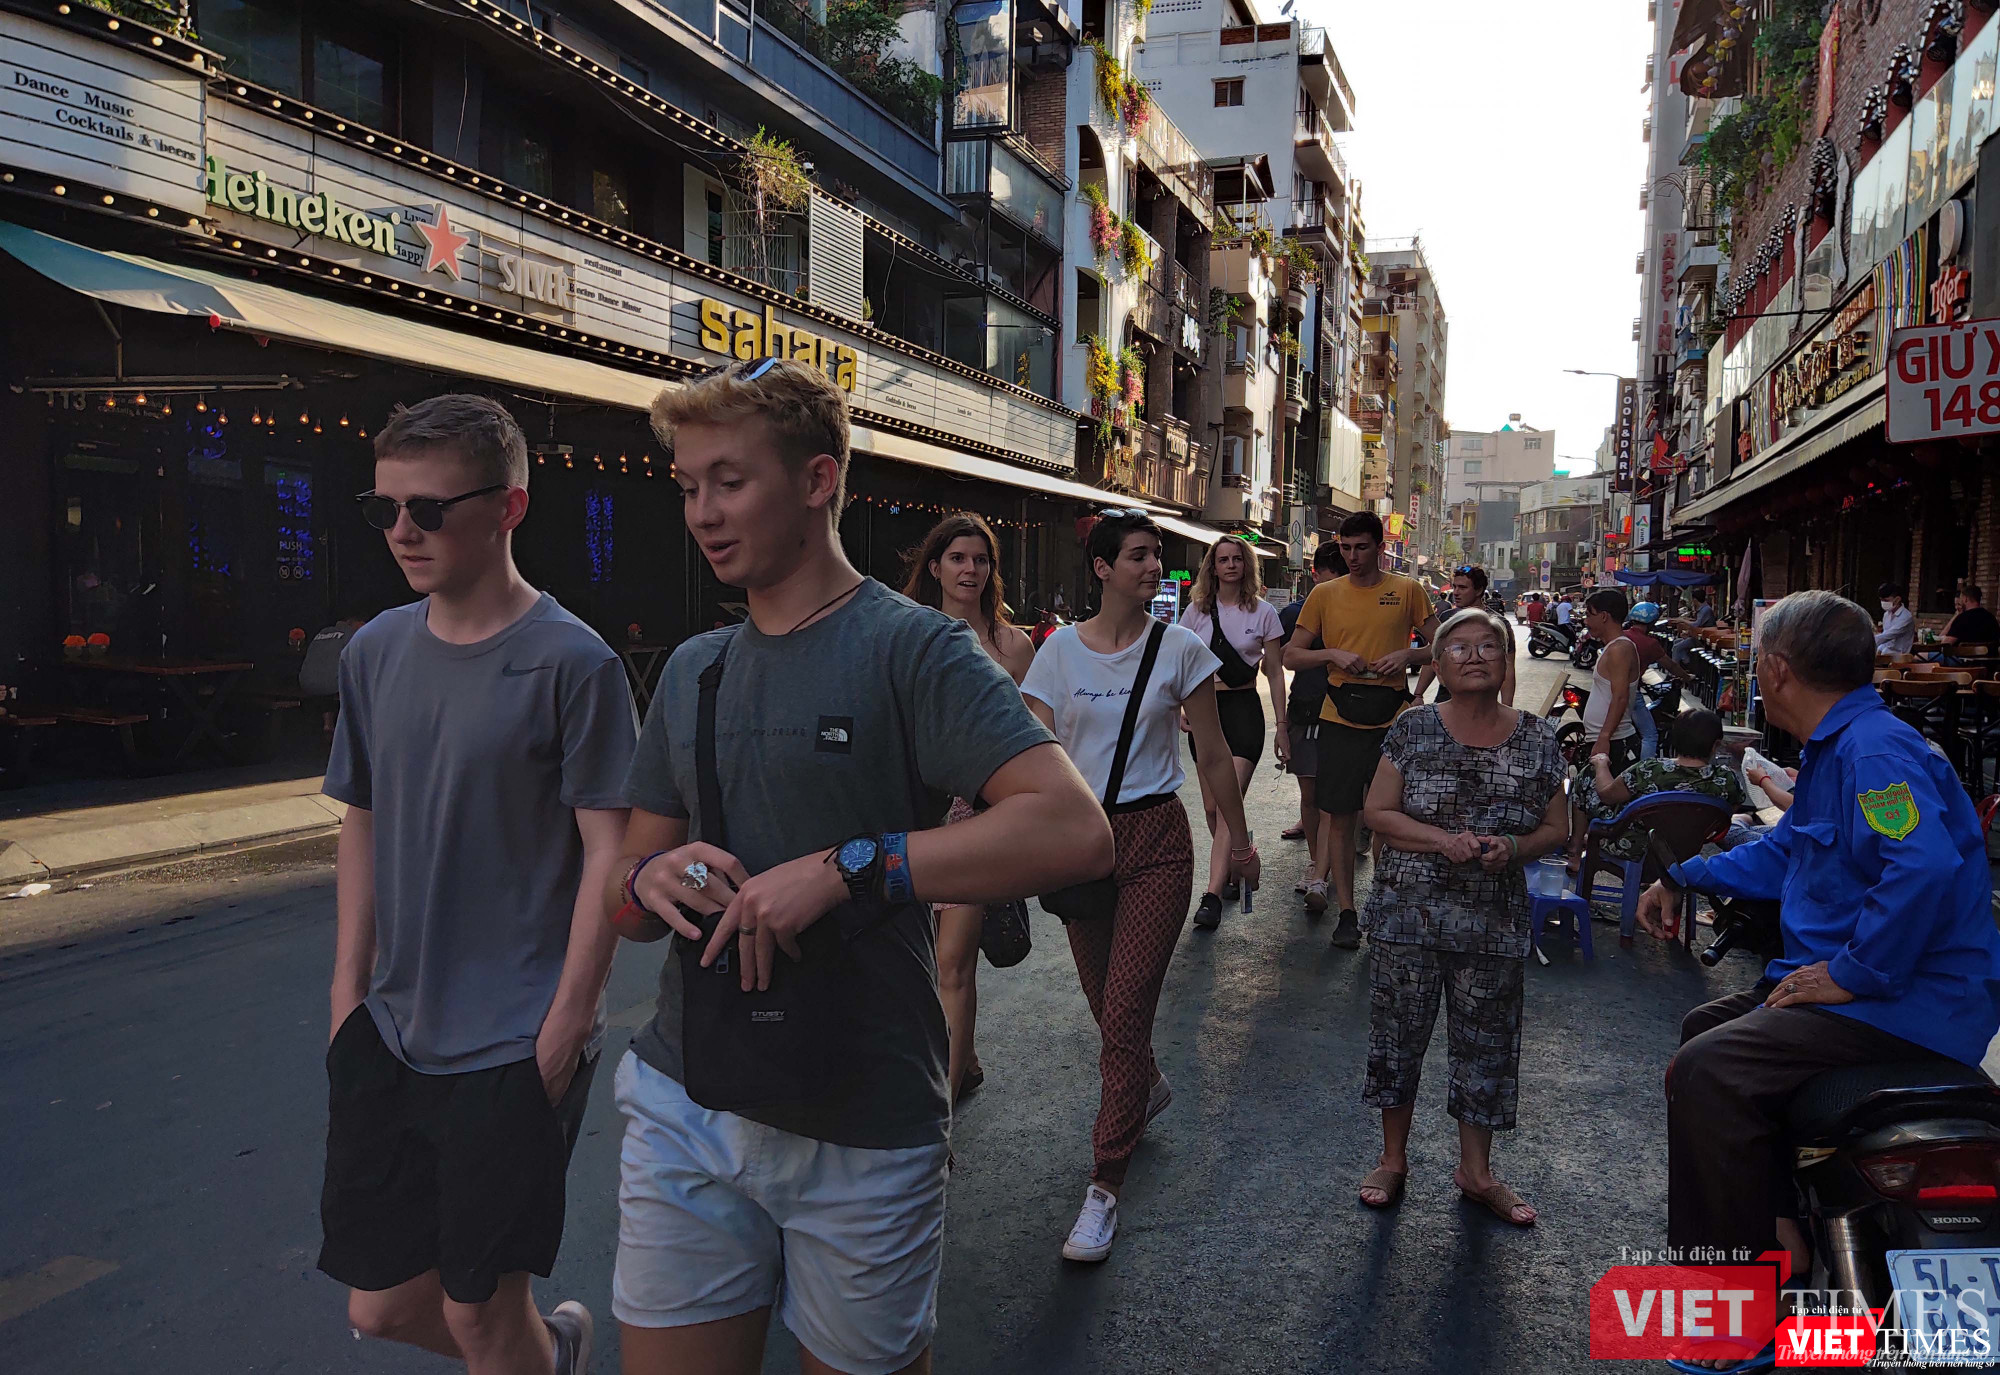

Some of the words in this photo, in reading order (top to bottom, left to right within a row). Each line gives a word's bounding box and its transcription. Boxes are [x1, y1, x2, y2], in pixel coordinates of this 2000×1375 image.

[14, 71, 70, 99] Dance
[84, 91, 135, 118] Music
[55, 108, 134, 142] Cocktails
[140, 133, 152, 147] &
[159, 138, 196, 161] beers
[207, 155, 398, 256] Heineken
[498, 253, 571, 309] SILVER
[1661, 233, 1677, 302] HAPPY
[700, 298, 857, 393] sahara
[1658, 310, 1672, 351] INN
[1169, 570, 1191, 581] SPA
[1106, 689, 1117, 698] be
[1932, 1216, 1982, 1225] HONDA
